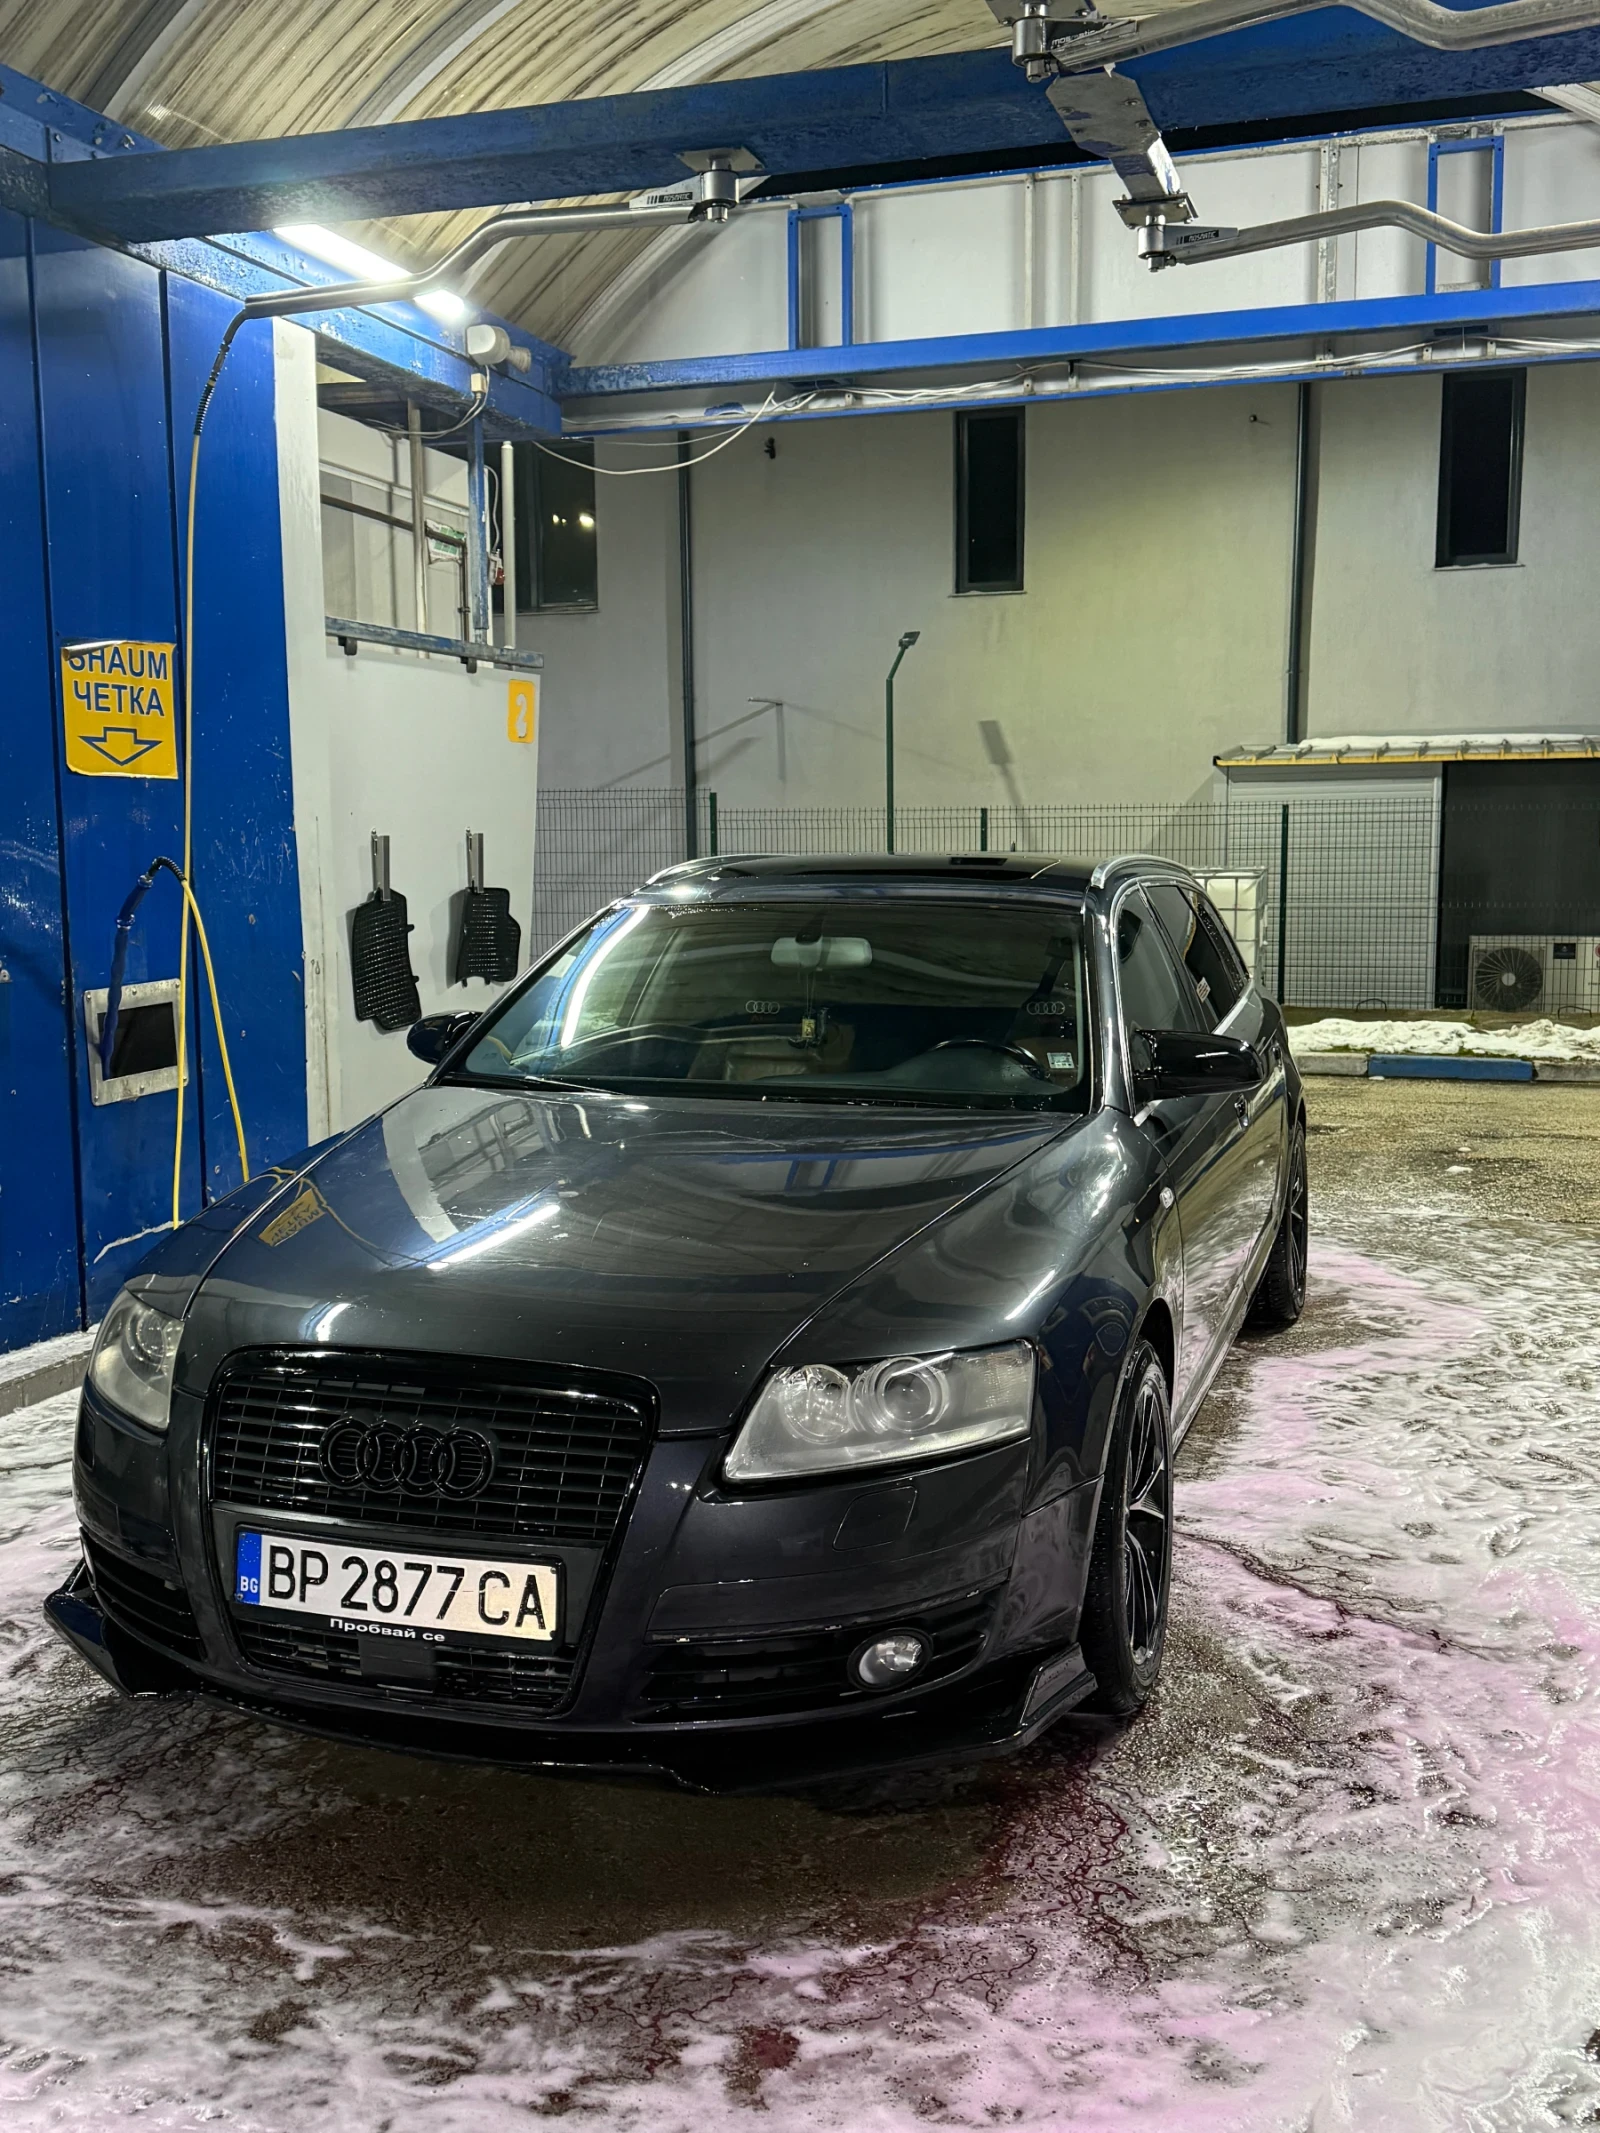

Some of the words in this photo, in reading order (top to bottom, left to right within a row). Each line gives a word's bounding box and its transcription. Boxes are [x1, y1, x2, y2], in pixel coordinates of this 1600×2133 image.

[74, 680, 165, 717] ЧЕТКА
[240, 1575, 259, 1594] BG
[340, 1555, 465, 1620] 2877
[330, 1618, 416, 1639] Пробвай
